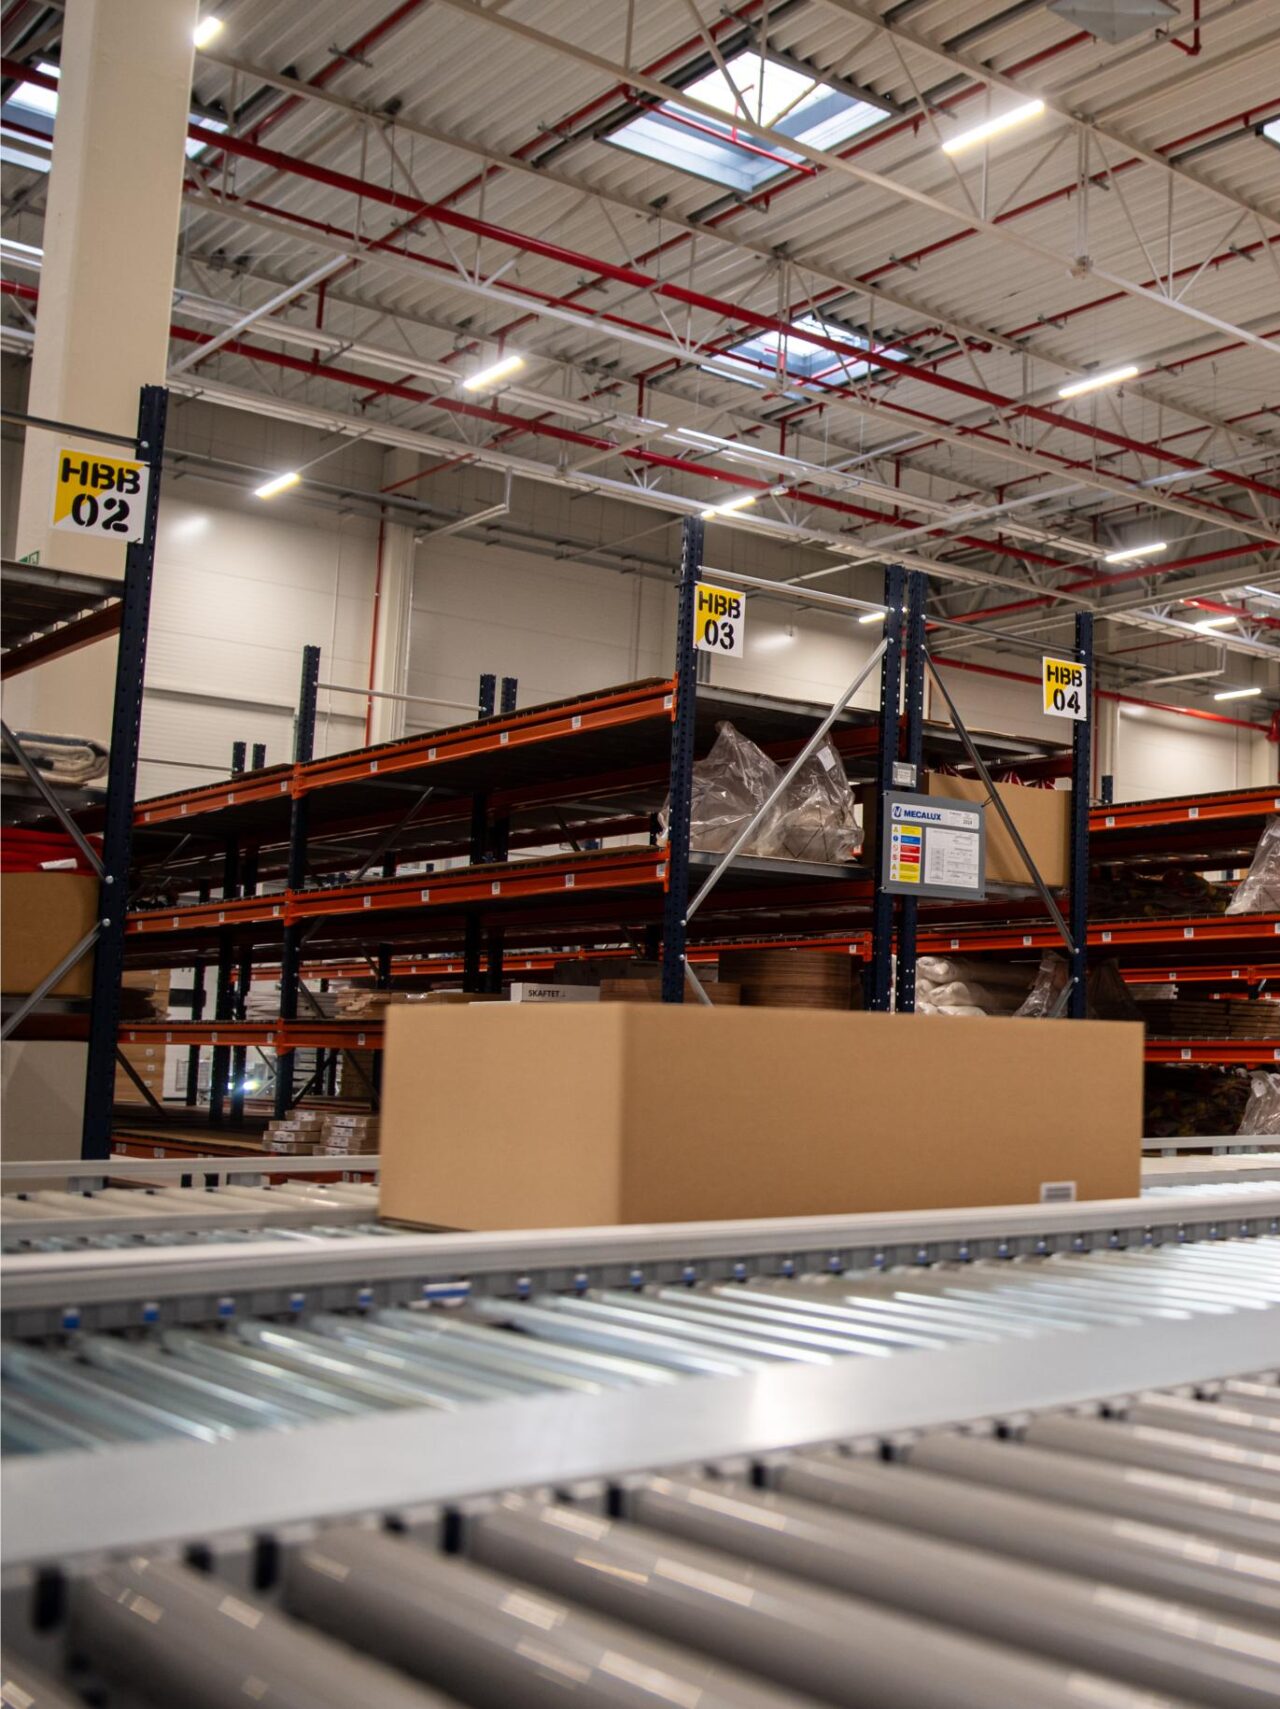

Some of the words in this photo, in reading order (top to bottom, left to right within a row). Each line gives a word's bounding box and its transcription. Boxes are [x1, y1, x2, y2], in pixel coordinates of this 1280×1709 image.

[62, 457, 140, 494] HBB
[72, 493, 130, 532] 02
[698, 591, 741, 619] HBB
[704, 619, 734, 650] 03
[1047, 664, 1082, 687] HBB
[1053, 688, 1081, 714] 04
[904, 809, 941, 821] MECALUX
[528, 989, 560, 998] SKAFTET
